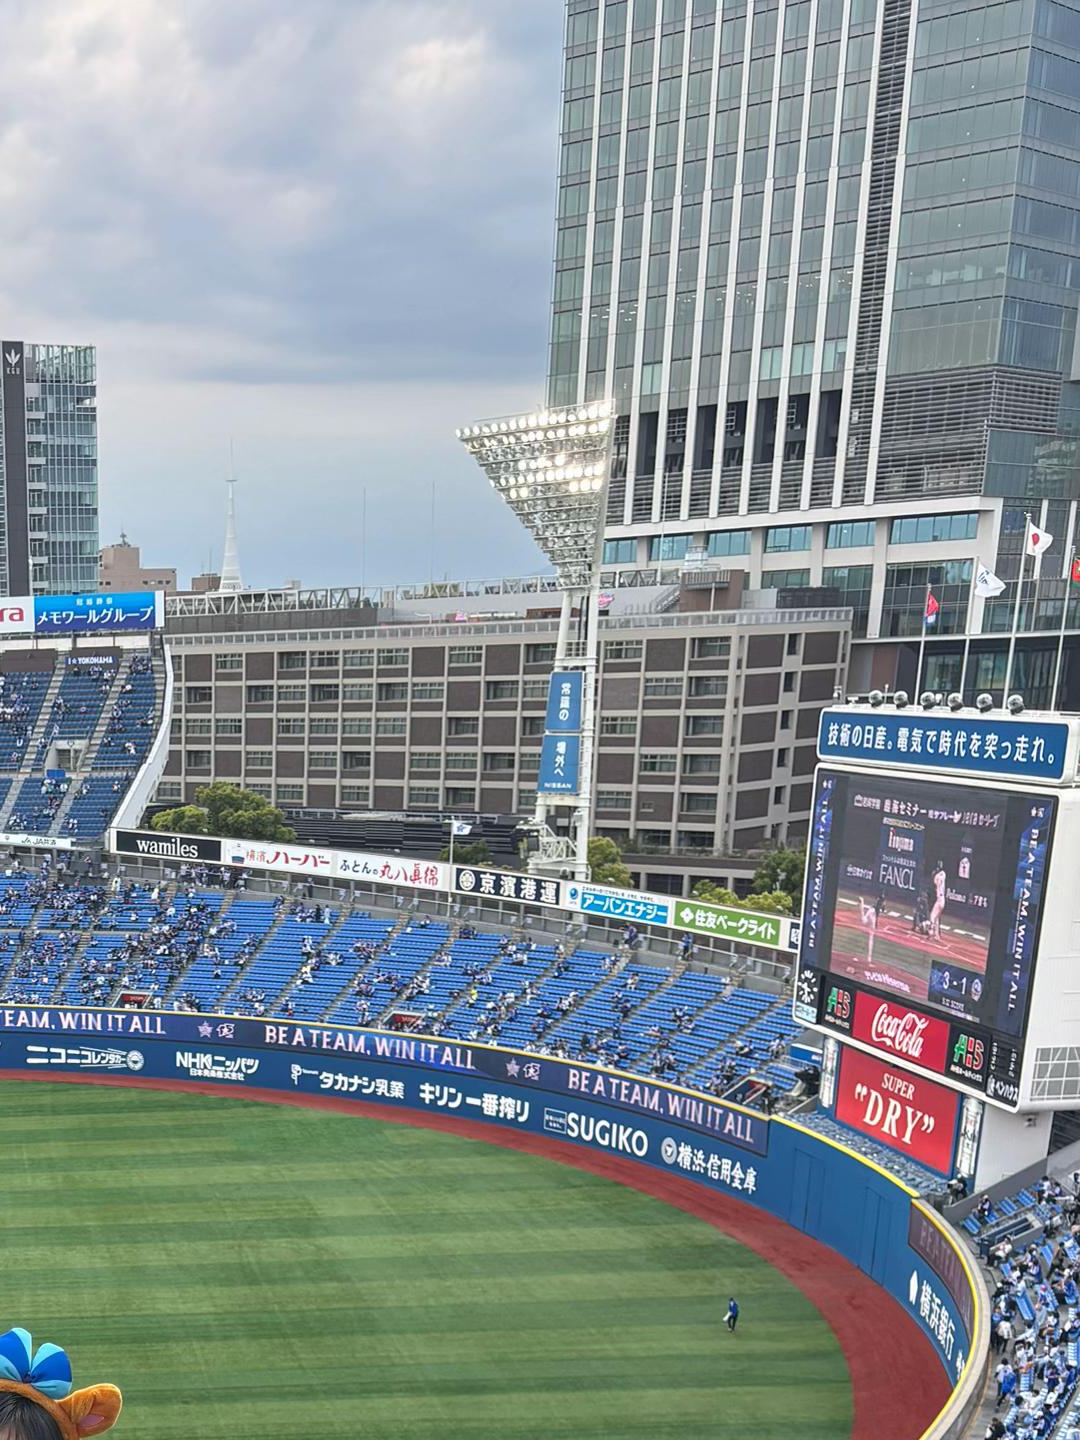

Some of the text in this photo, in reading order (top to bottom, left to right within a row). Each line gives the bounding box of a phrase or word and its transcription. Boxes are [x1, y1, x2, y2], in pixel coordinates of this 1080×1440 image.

[37, 606, 153, 625] メモワールグループ
[136, 838, 199, 858] wamiles
[879, 864, 916, 891] FANCL
[582, 893, 669, 922] アーバンエナジー
[695, 908, 777, 940] 住友ベークライト
[61, 1011, 102, 1031] WIN
[108, 1013, 126, 1032] IT
[129, 1015, 166, 1035] ALL
[872, 1003, 929, 1059] Coca-Cola
[26, 1045, 128, 1066] ニコニコレンタカー
[264, 1025, 288, 1045] BE
[291, 1028, 307, 1047] A
[374, 1036, 416, 1061] WIN
[420, 1043, 437, 1064] IT
[440, 1045, 476, 1069] ALL
[320, 1071, 406, 1100] タカナシ乳業
[881, 1072, 916, 1101] SUPER
[568, 1068, 590, 1092] BE
[592, 1074, 608, 1097] A
[666, 1092, 704, 1125] WIN
[706, 1103, 723, 1128] IT
[722, 1110, 755, 1143] ALL
[566, 1112, 649, 1158] SUGIKO
[677, 1142, 757, 1195] 横浜信用金庫
[920, 1279, 956, 1361] 横浜銀行
